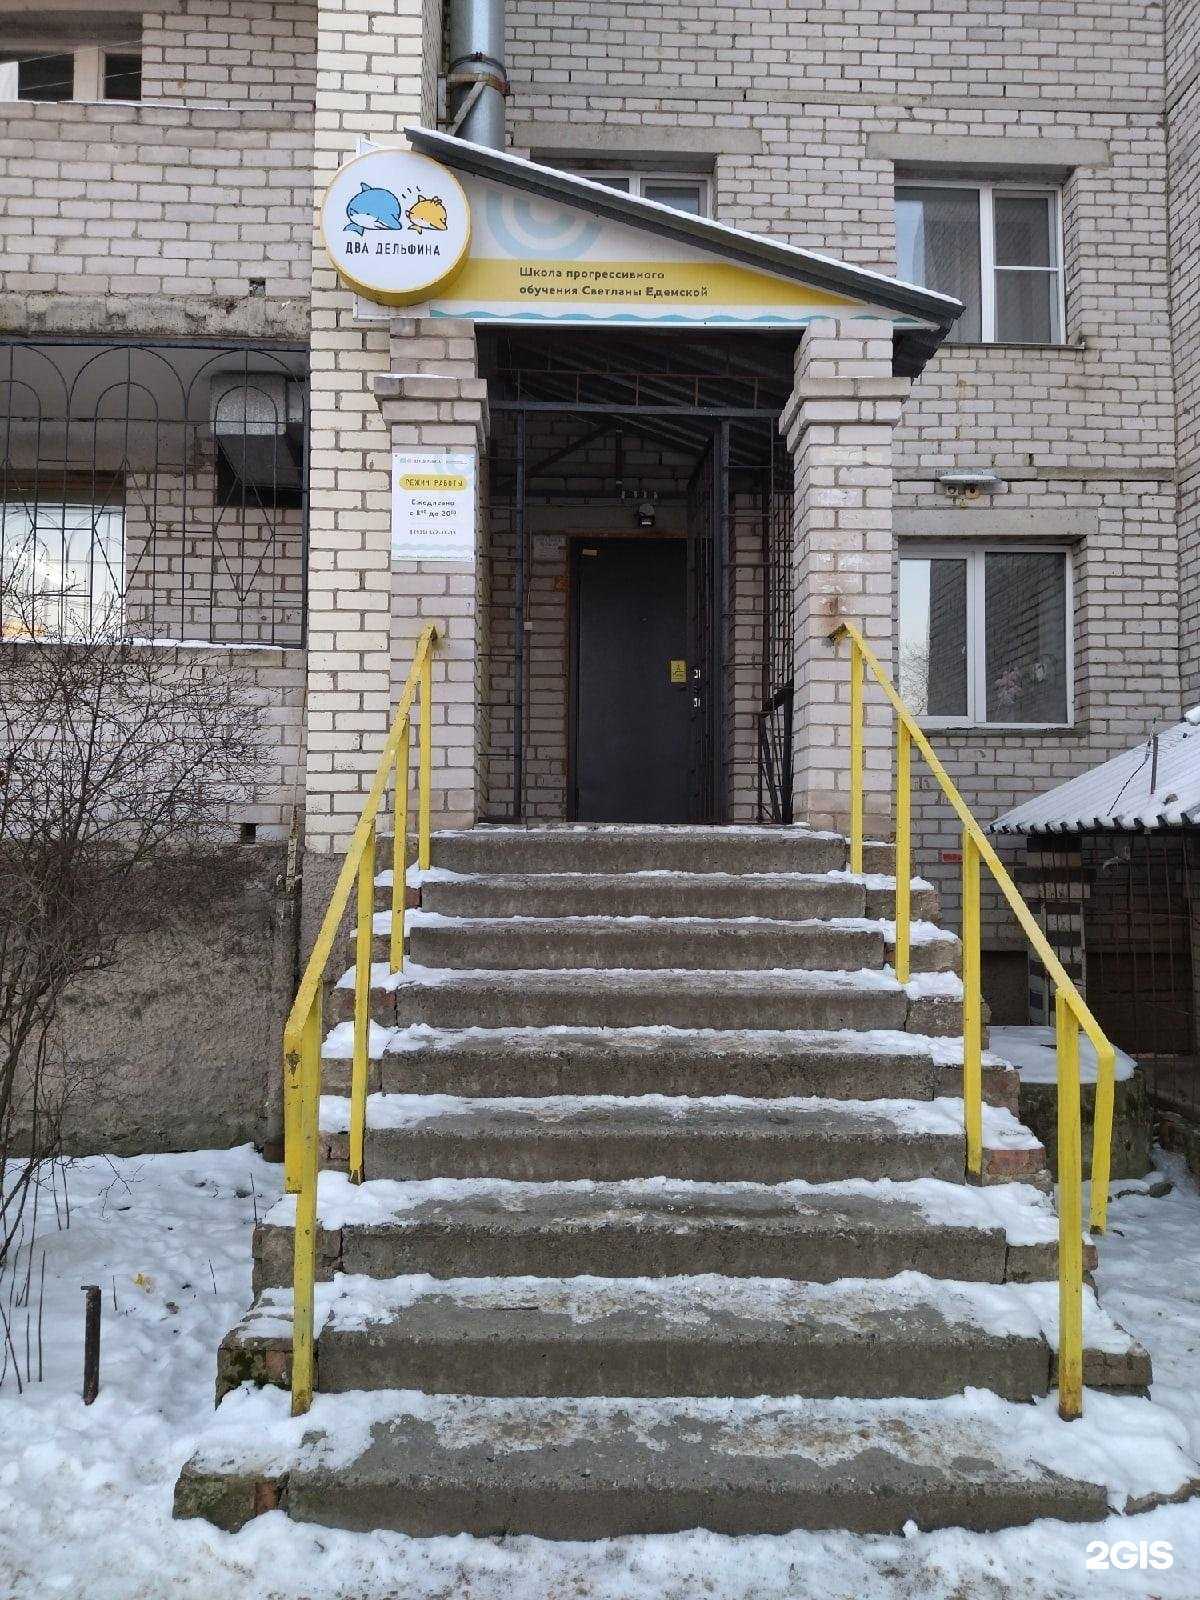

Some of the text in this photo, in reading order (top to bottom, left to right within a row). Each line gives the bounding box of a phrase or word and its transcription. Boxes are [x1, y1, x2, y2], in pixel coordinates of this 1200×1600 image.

[345, 241, 441, 256] ДВА ДЕЛЬФИНА
[519, 267, 665, 280] Школа прогрессивного
[519, 285, 578, 296] обучения
[581, 286, 642, 297] Светланы
[433, 479, 463, 487] РАБОТЫ
